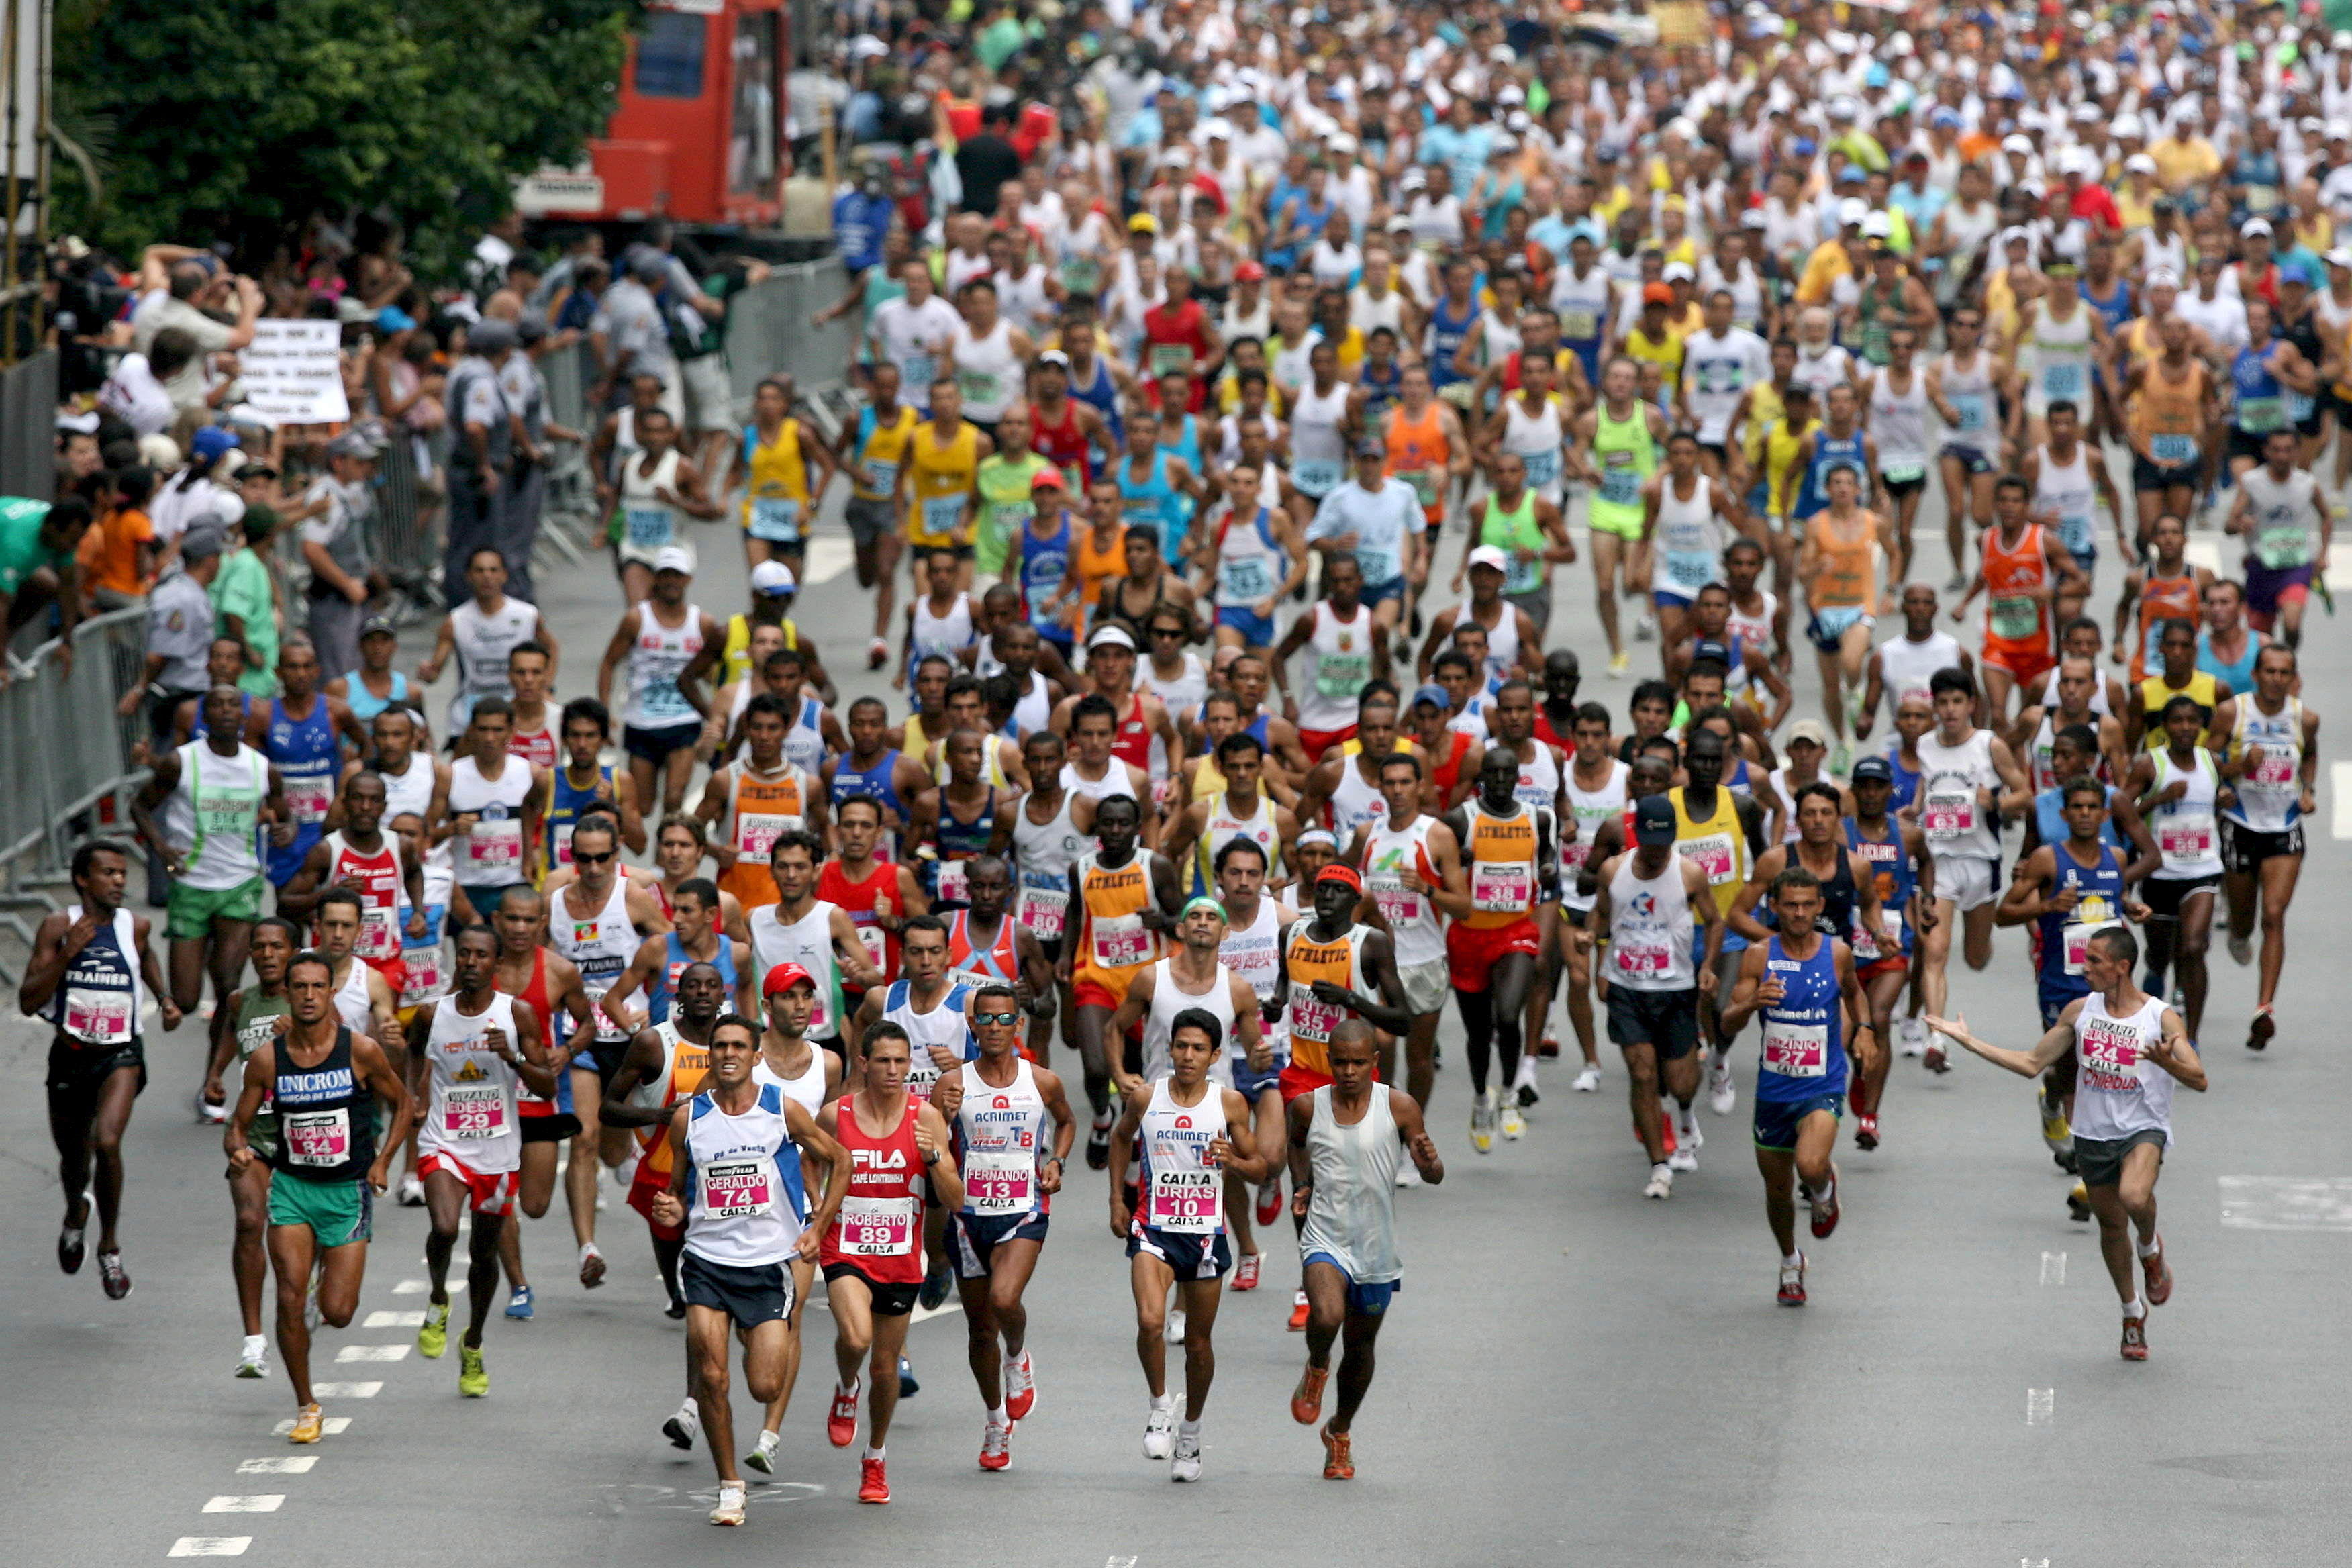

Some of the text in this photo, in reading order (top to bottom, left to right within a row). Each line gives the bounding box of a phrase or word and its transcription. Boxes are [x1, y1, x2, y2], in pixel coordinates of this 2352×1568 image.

[1477, 826, 1530, 839] ATHLETIC
[1086, 873, 1144, 889] ATHLETIC
[1489, 886, 1515, 901] 38
[1106, 940, 1135, 957] 95
[1289, 946, 1348, 963] ATHLETIC
[66, 970, 130, 987] TRAINER
[1767, 1008, 1810, 1019] Unimed
[81, 1018, 109, 1033] 18
[1298, 1012, 1324, 1031] 35
[1779, 1050, 1806, 1065] 27
[2090, 1042, 2118, 1062] 24
[277, 1069, 353, 1094] UNICROM
[448, 1089, 499, 1102] WIZARD
[446, 1099, 502, 1114] EDESIO
[458, 1113, 490, 1129] 29
[975, 1112, 1028, 1123] ACRIMET
[288, 1124, 344, 1139] LUCIANO
[457, 1128, 494, 1139] CAIXA
[1157, 1130, 1211, 1141] ACRIMET
[303, 1139, 333, 1155] 84
[851, 1148, 907, 1169] FILA
[852, 1171, 869, 1184] CAFÉ
[968, 1169, 1028, 1181] FERNANDO
[1161, 1173, 1211, 1185] CAIXA
[707, 1175, 766, 1191] GERALDO
[982, 1181, 1010, 1197] 13
[720, 1189, 753, 1207] 74
[1156, 1185, 1215, 1199] URIAS
[979, 1198, 1016, 1208] CAIXA
[1170, 1199, 1198, 1216] 10
[720, 1206, 757, 1217] CAIXA
[846, 1213, 907, 1226] ROBERTO
[1168, 1216, 1204, 1226] CAIXA
[859, 1226, 892, 1243] 89
[858, 1245, 894, 1254] CAIXA
